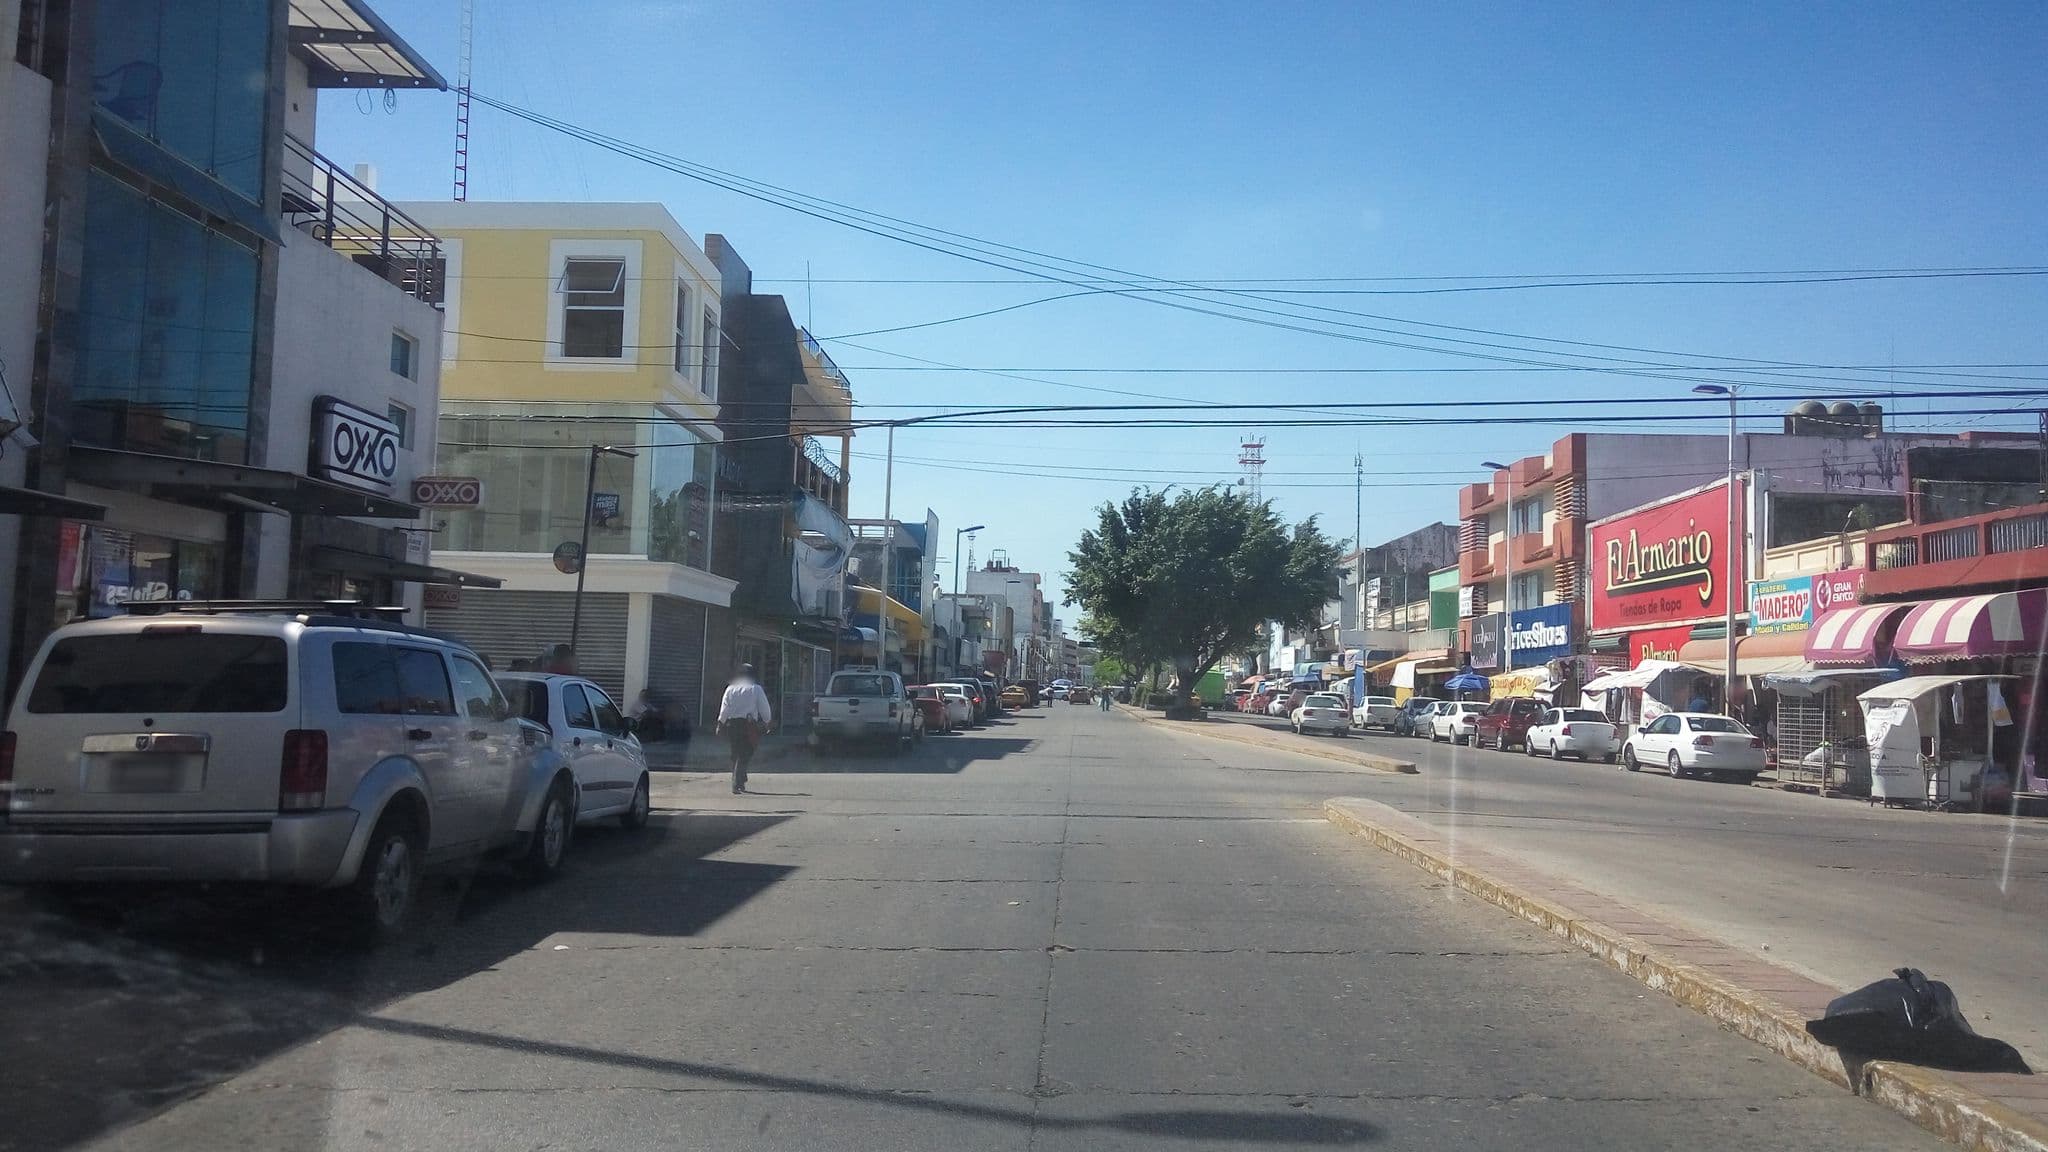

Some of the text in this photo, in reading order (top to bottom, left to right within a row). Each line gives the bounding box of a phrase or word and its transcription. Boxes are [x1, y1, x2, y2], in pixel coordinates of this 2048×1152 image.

[334, 422, 396, 477] OXXO
[416, 483, 477, 503] OXXO
[1623, 517, 1712, 582] Armario
[1833, 582, 1852, 592] GRAN
[1619, 598, 1682, 616] Tiendas de Ropa
